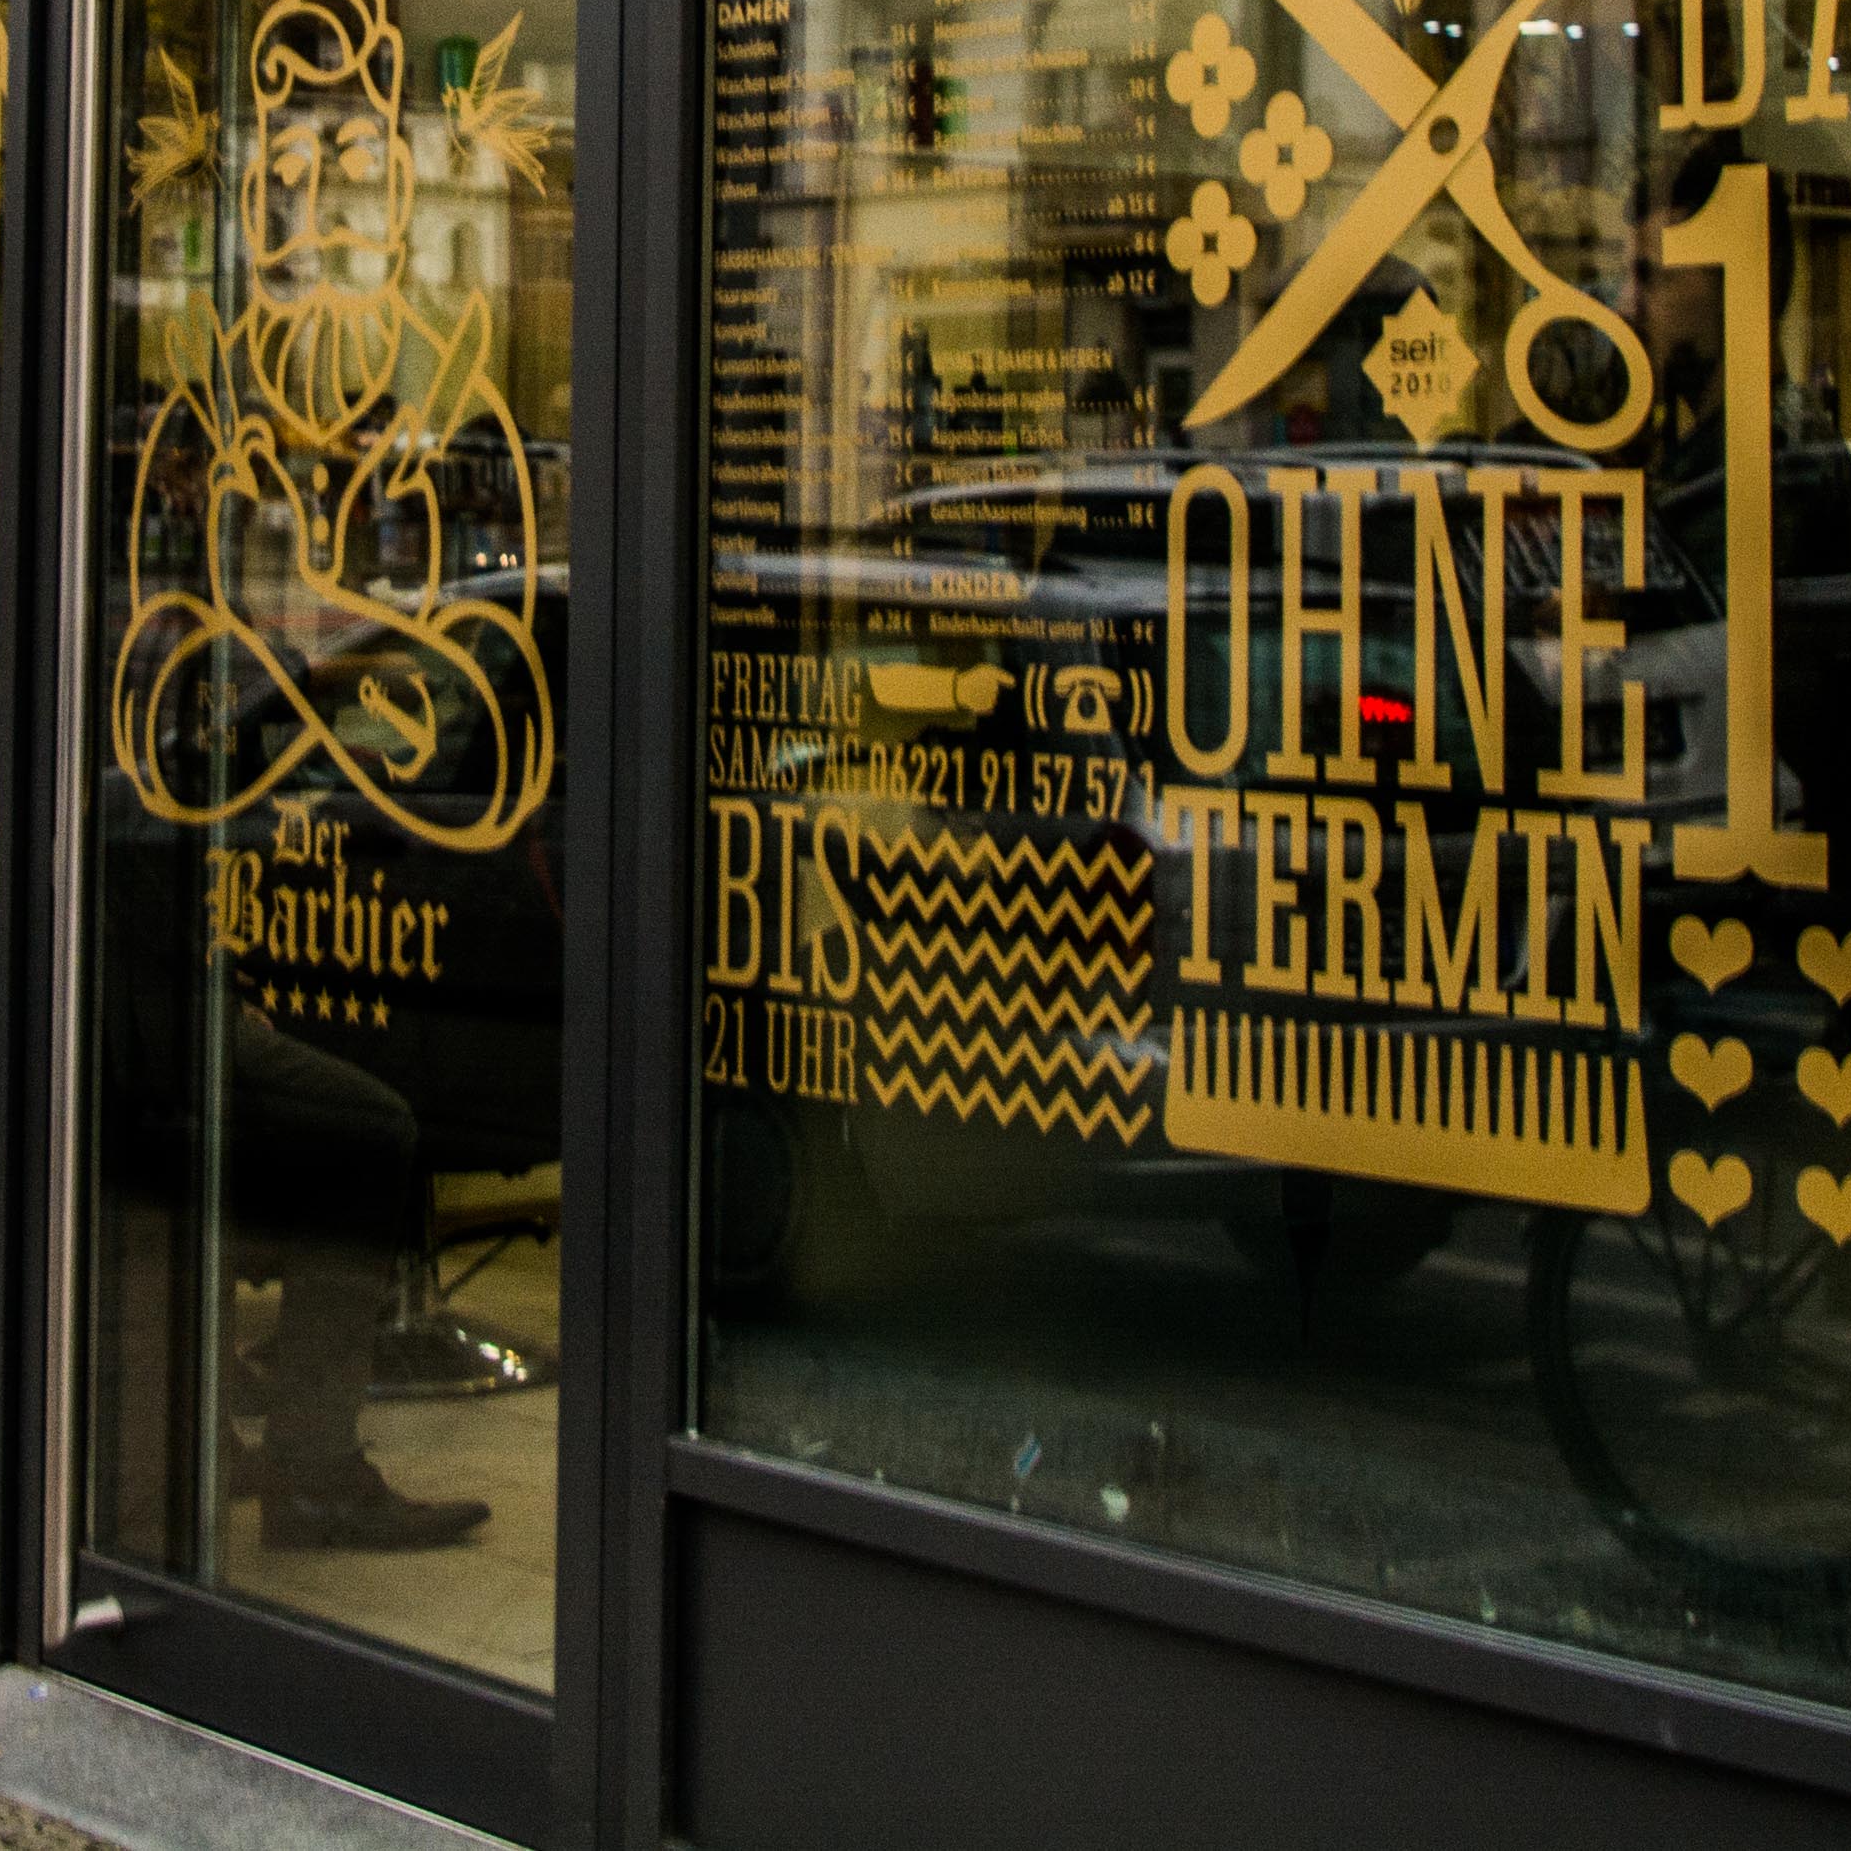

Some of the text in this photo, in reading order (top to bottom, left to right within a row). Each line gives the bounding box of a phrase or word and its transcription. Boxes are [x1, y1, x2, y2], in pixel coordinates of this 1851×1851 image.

[1390, 331, 1445, 366] seit
[931, 569, 1022, 601] KINDER
[1165, 462, 1646, 804] OHNE
[711, 651, 861, 729] FREITAG
[709, 725, 860, 796] SAMSTAG
[868, 739, 965, 809] 06221
[980, 748, 1016, 814] 91
[1031, 752, 1074, 819] 57
[1085, 756, 1129, 823] 57
[272, 788, 350, 868] Der
[205, 847, 449, 983] Barbier
[706, 797, 861, 1001] BIS
[1158, 785, 1652, 1032] TERMIN
[704, 994, 858, 1104] 21 UHR
